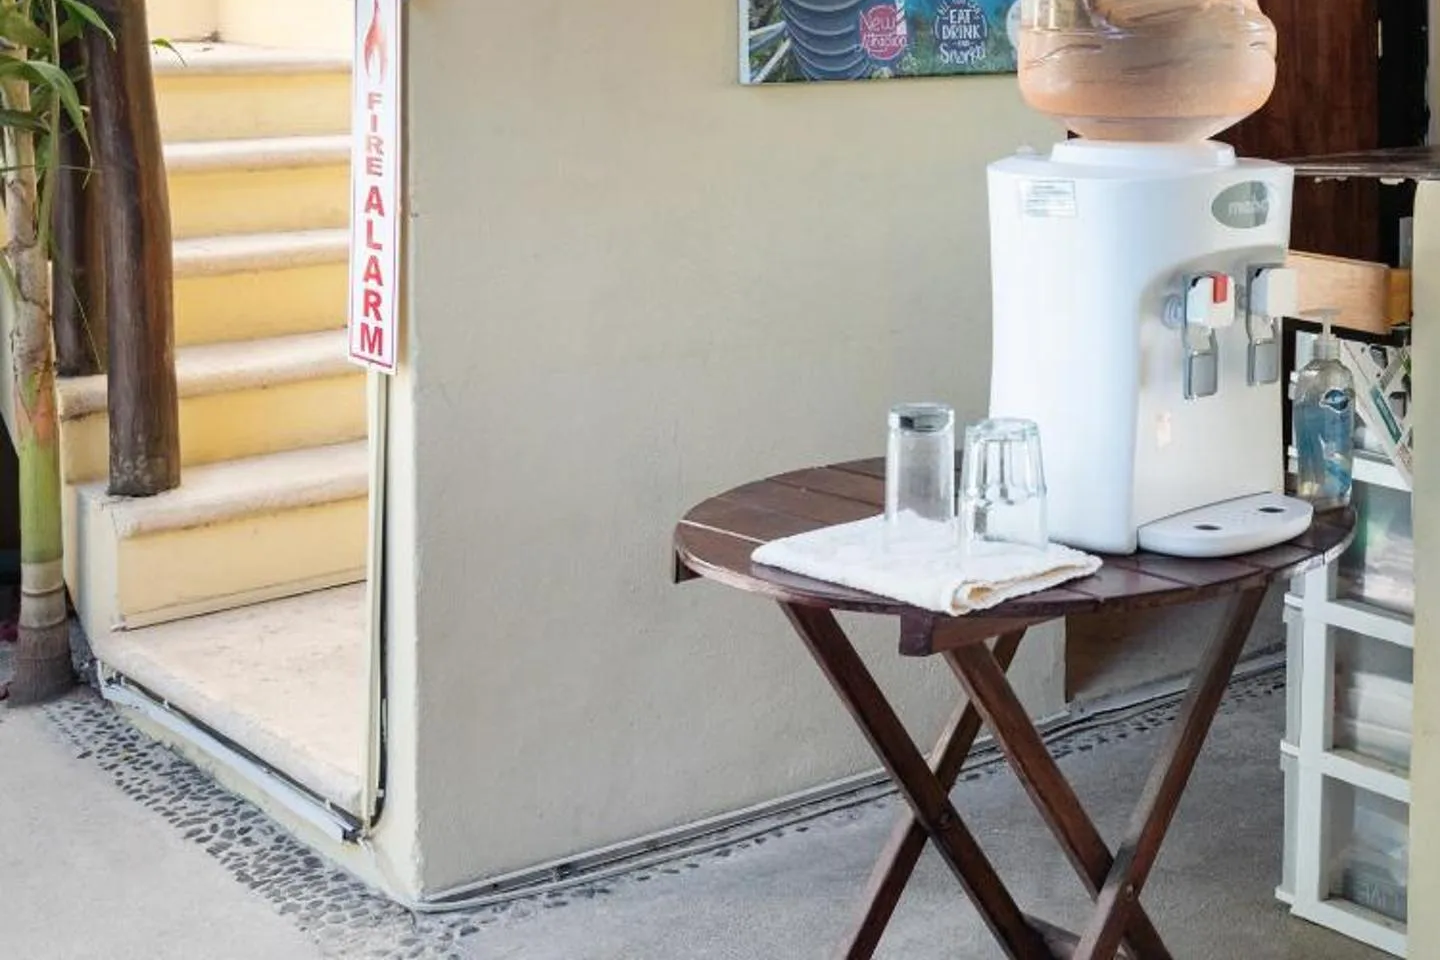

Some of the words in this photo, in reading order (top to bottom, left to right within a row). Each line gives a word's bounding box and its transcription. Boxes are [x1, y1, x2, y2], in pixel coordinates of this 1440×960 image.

[941, 24, 981, 40] DRINK
[949, 8, 971, 24] EAT
[365, 91, 385, 178] FIRE
[360, 184, 385, 357] ALARM
